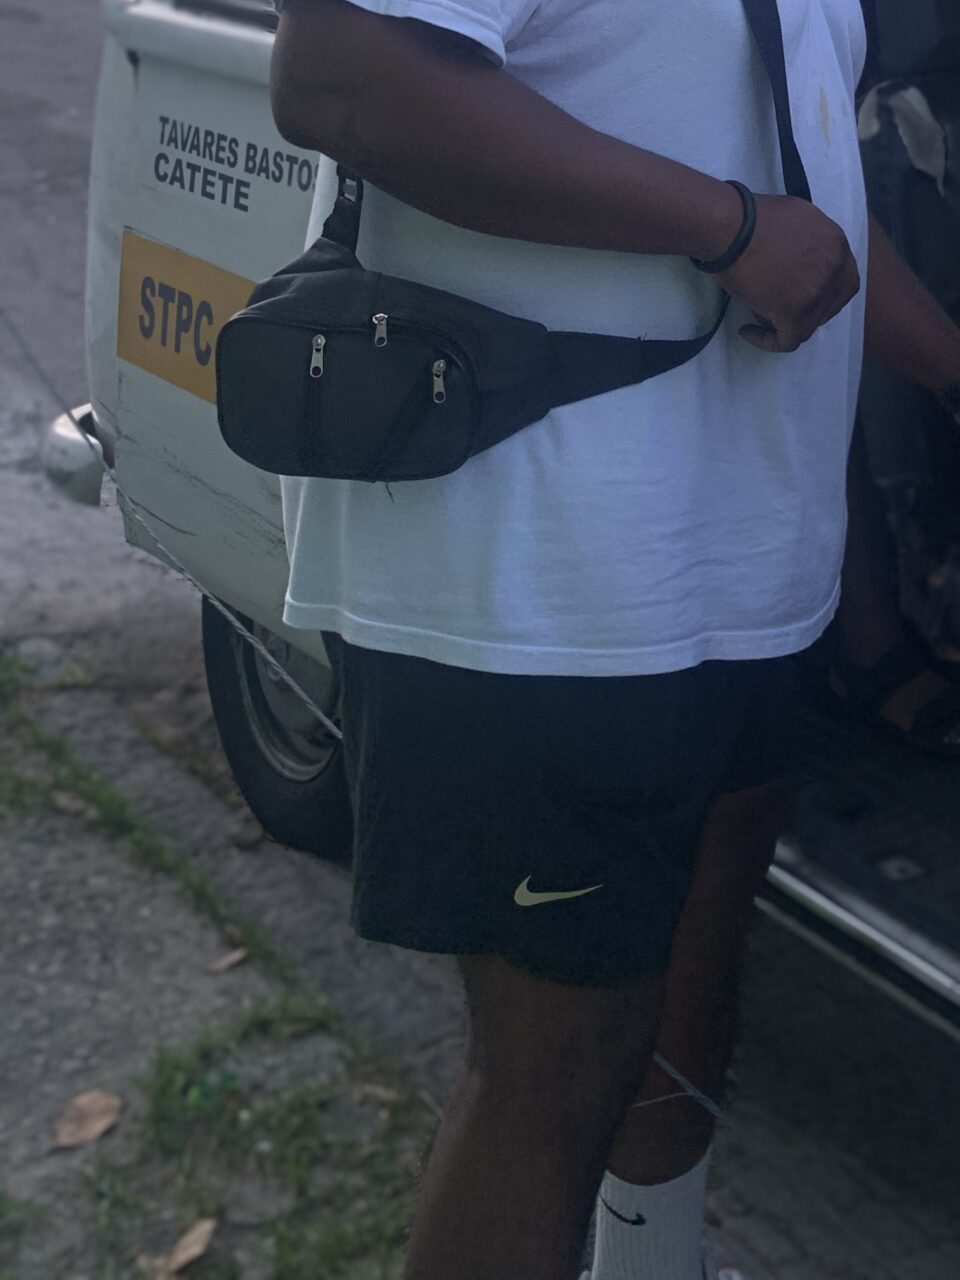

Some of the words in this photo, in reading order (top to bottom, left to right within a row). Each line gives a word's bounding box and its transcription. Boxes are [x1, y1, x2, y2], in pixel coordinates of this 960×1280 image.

[159, 115, 240, 169] TAVARES
[153, 152, 251, 213] CATETE
[138, 276, 215, 367] STPC
